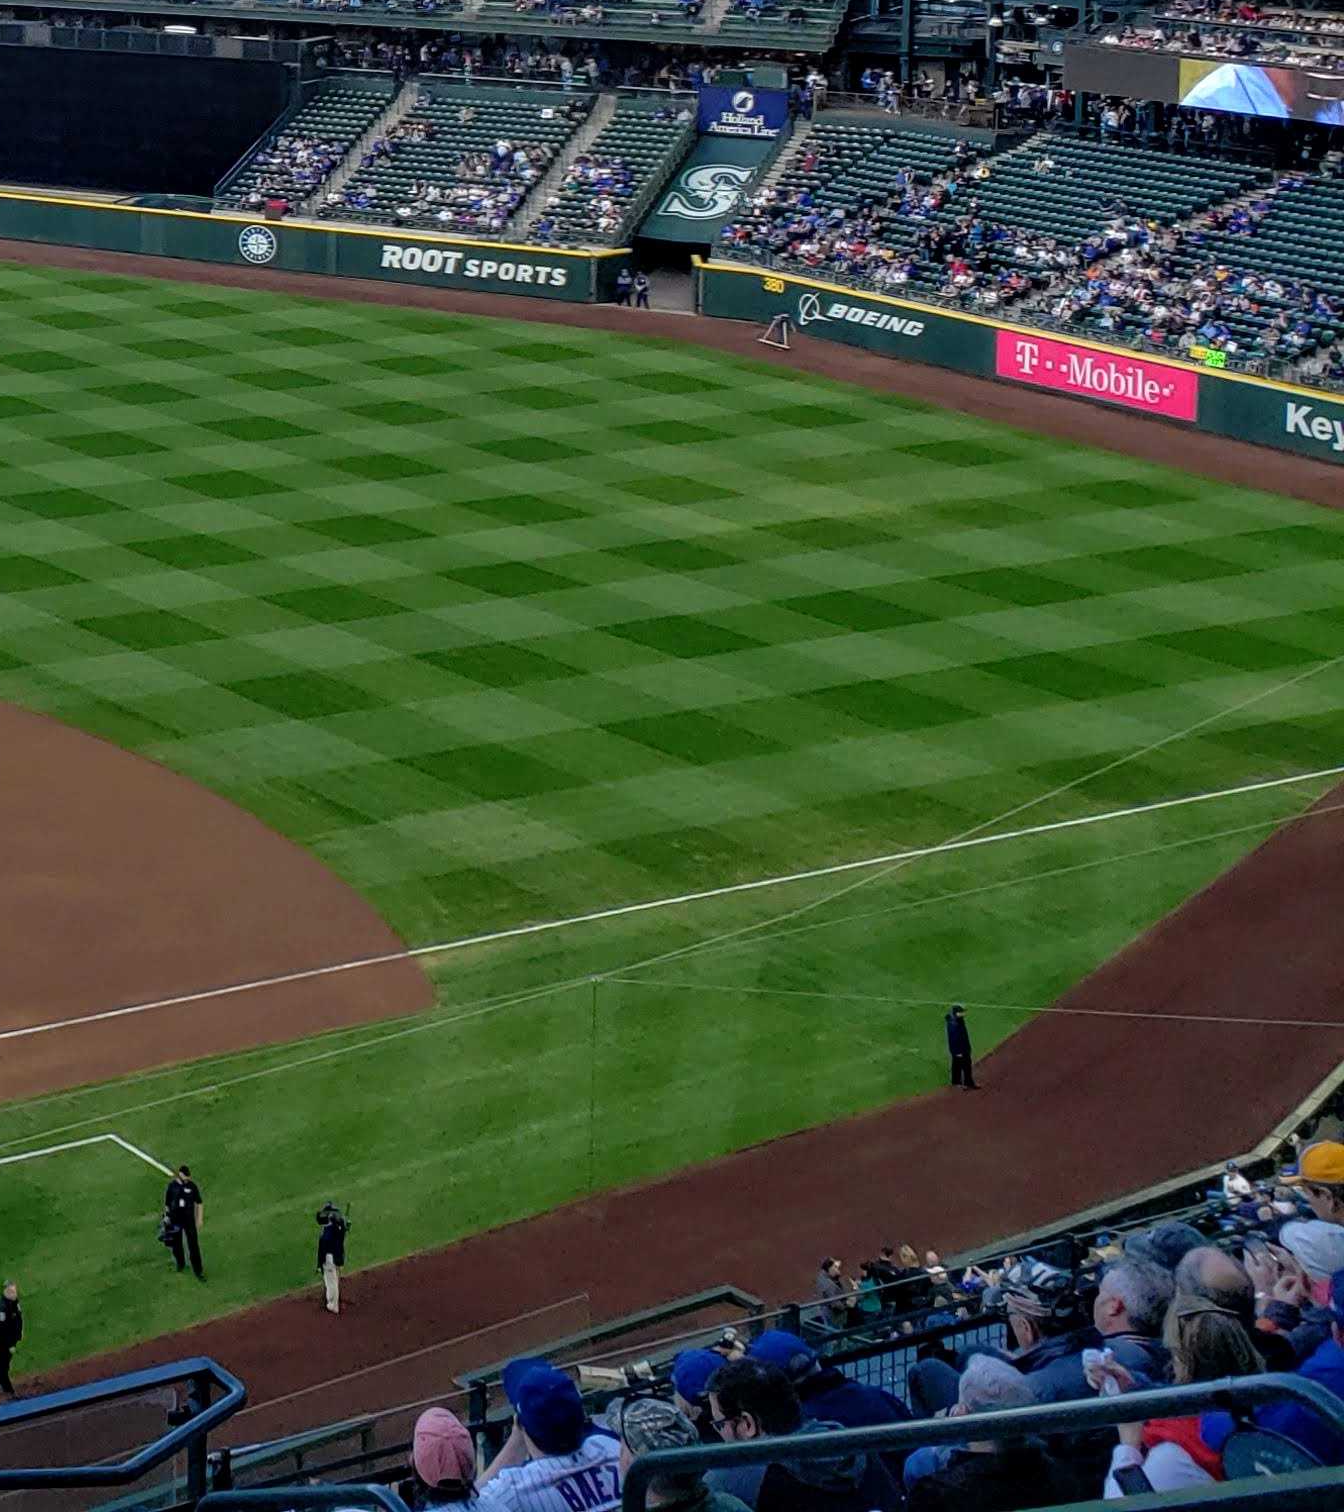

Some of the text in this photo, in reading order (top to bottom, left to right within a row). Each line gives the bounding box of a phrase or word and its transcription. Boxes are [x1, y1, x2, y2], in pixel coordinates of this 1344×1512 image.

[380, 245, 567, 287] ROOT SPORTS
[763, 277, 785, 294] 380
[826, 303, 925, 336] BOEING
